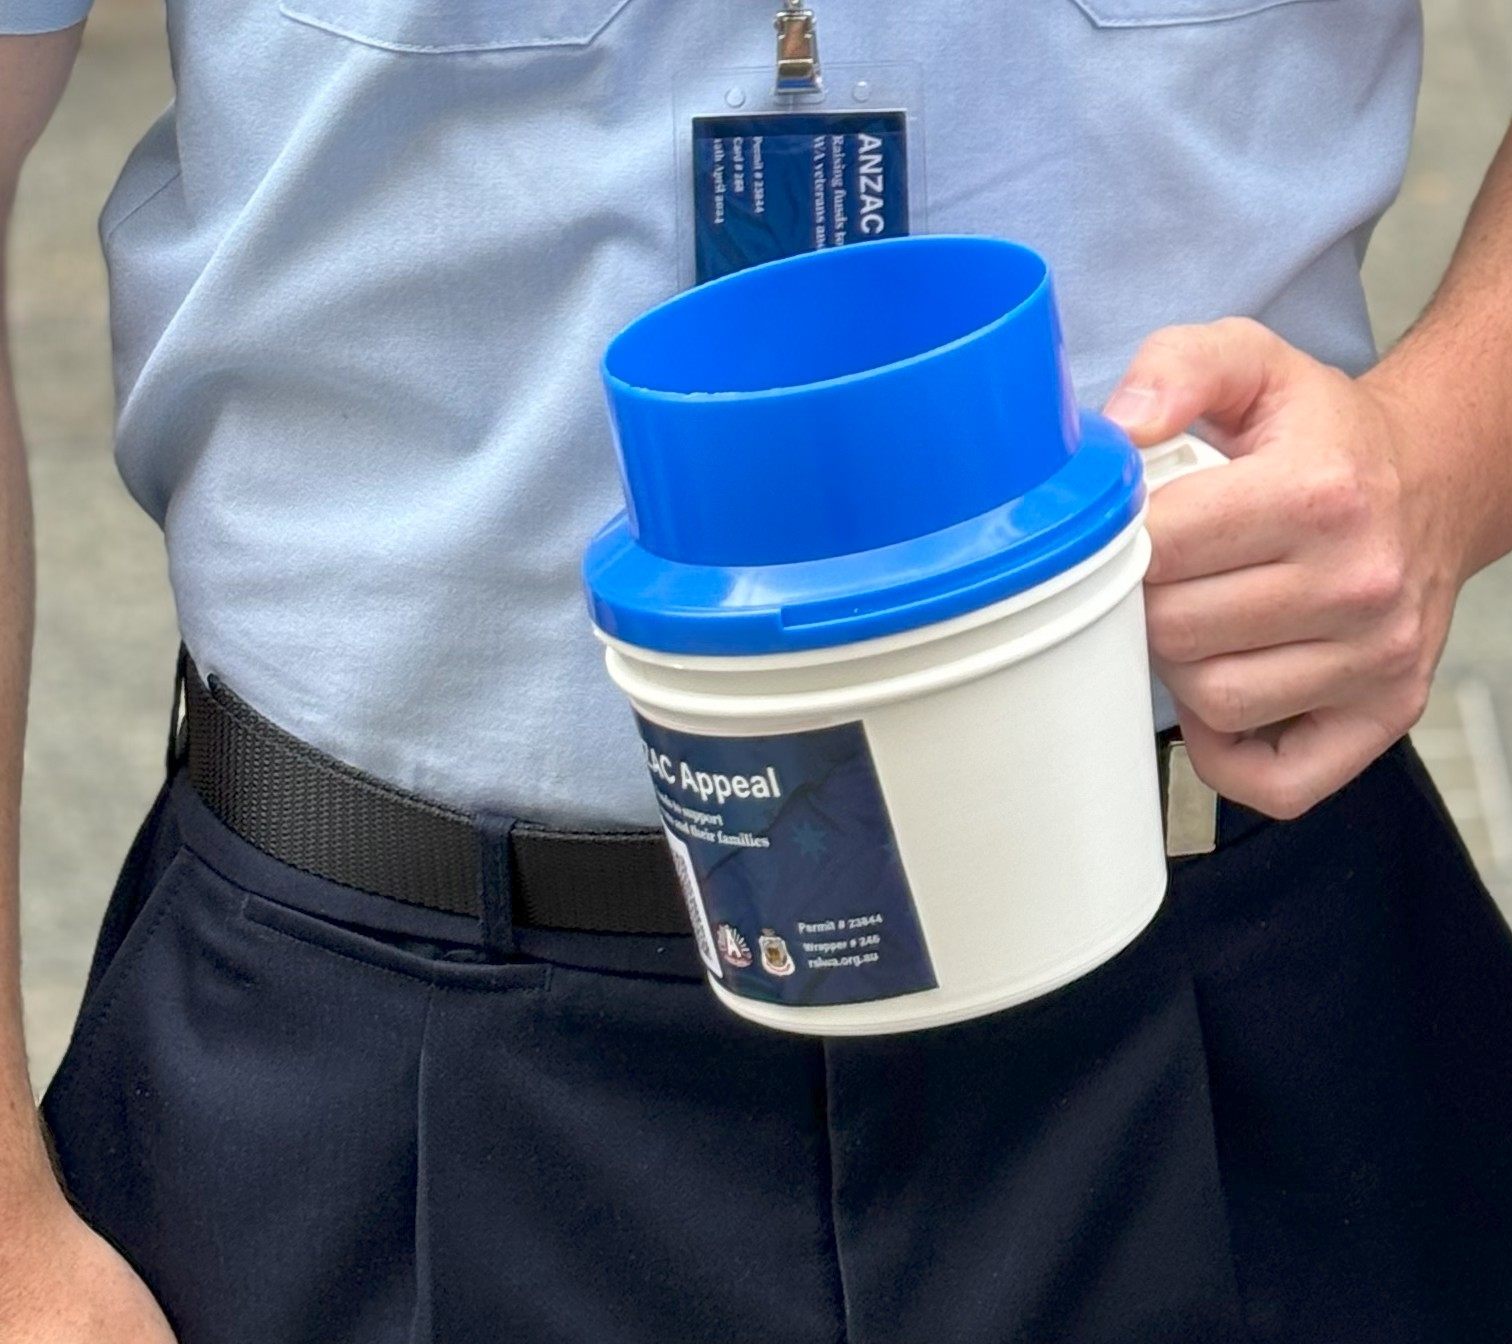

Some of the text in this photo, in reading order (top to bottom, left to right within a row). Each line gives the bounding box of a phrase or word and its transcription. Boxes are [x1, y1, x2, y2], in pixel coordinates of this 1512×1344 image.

[813, 136, 826, 161] WA
[832, 135, 845, 187] Raising
[814, 163, 827, 223] veterans
[857, 133, 885, 235] ANZAC
[834, 190, 848, 229] funds
[680, 760, 781, 805] Appeal
